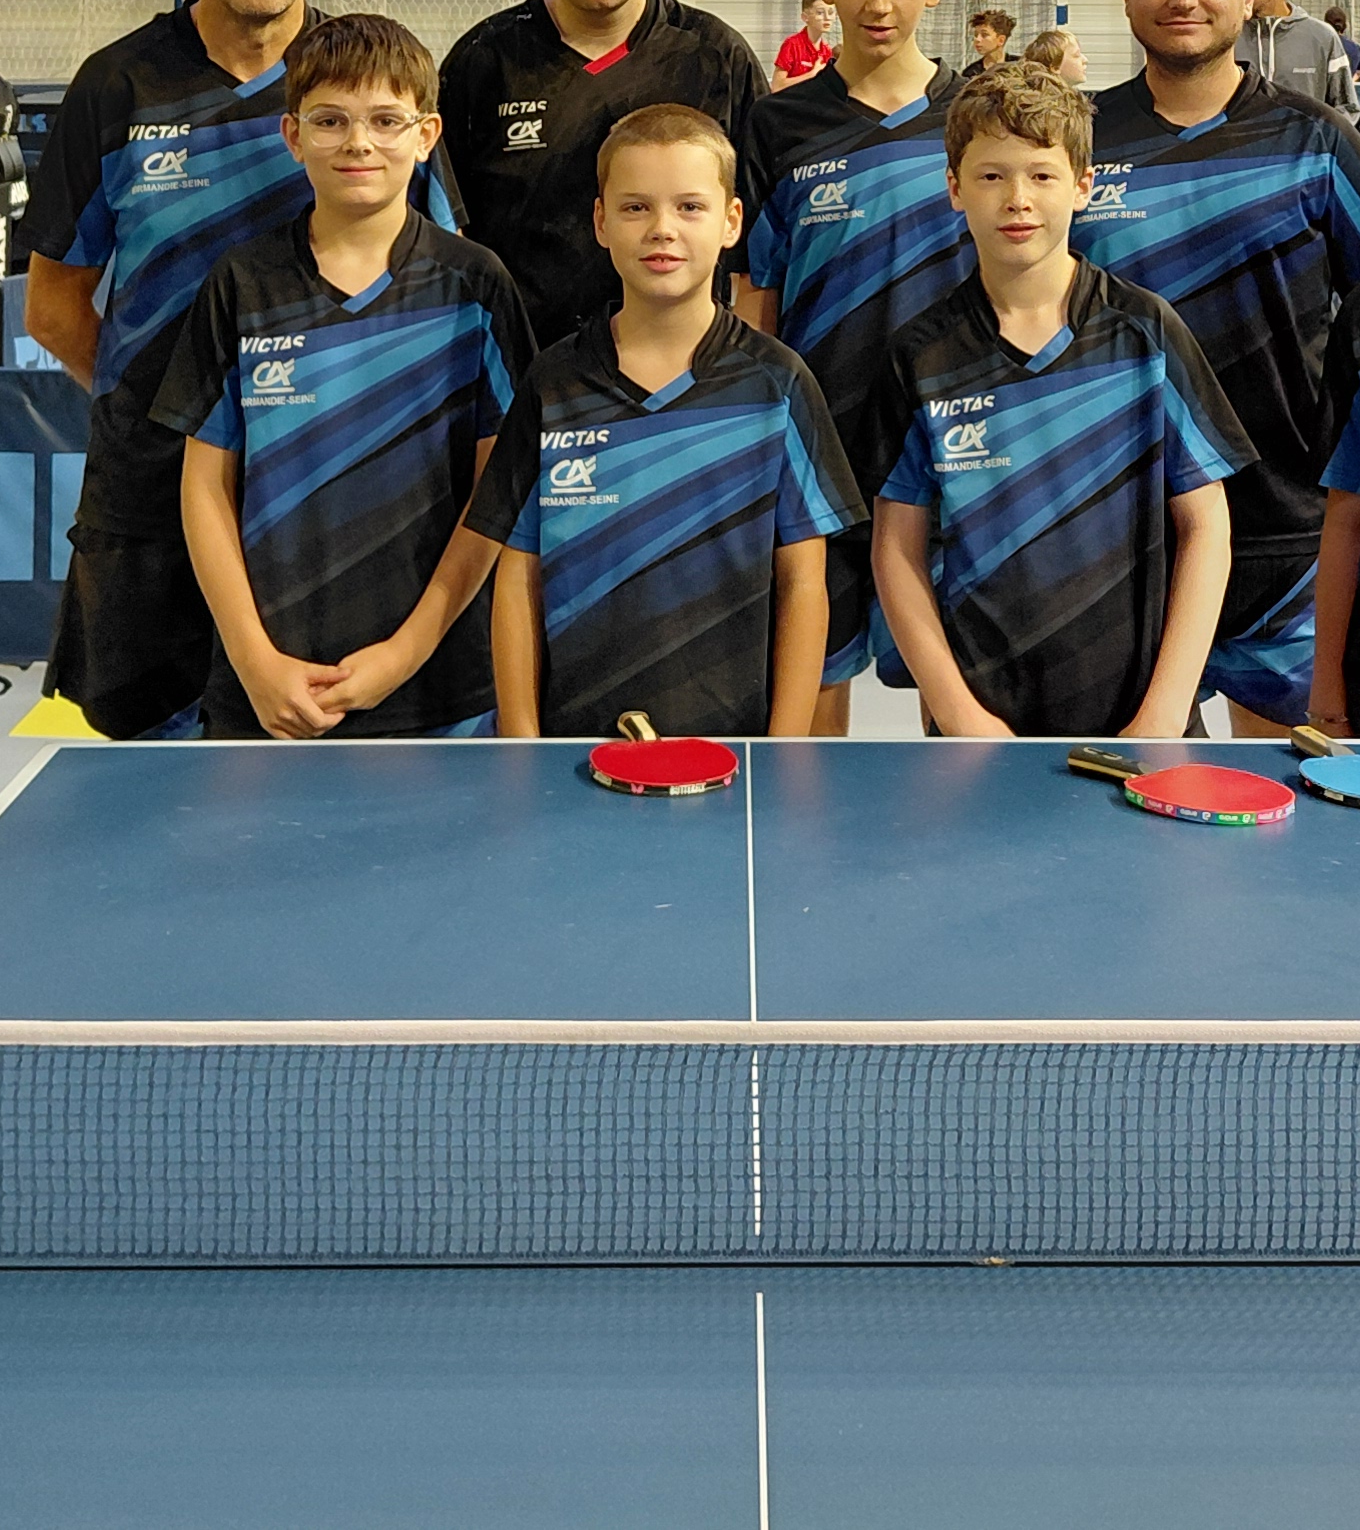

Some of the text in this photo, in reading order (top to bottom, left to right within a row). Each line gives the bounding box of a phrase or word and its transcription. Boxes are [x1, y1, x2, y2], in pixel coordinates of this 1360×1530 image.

[498, 100, 548, 118] VICTAS
[128, 123, 191, 142] VICTAS
[793, 159, 848, 183] VICTAS
[241, 335, 306, 354] VICTAS
[240, 393, 317, 408] ORMANDIE-SEINE
[929, 395, 995, 418] VICTAS
[541, 429, 610, 450] VICTAS
